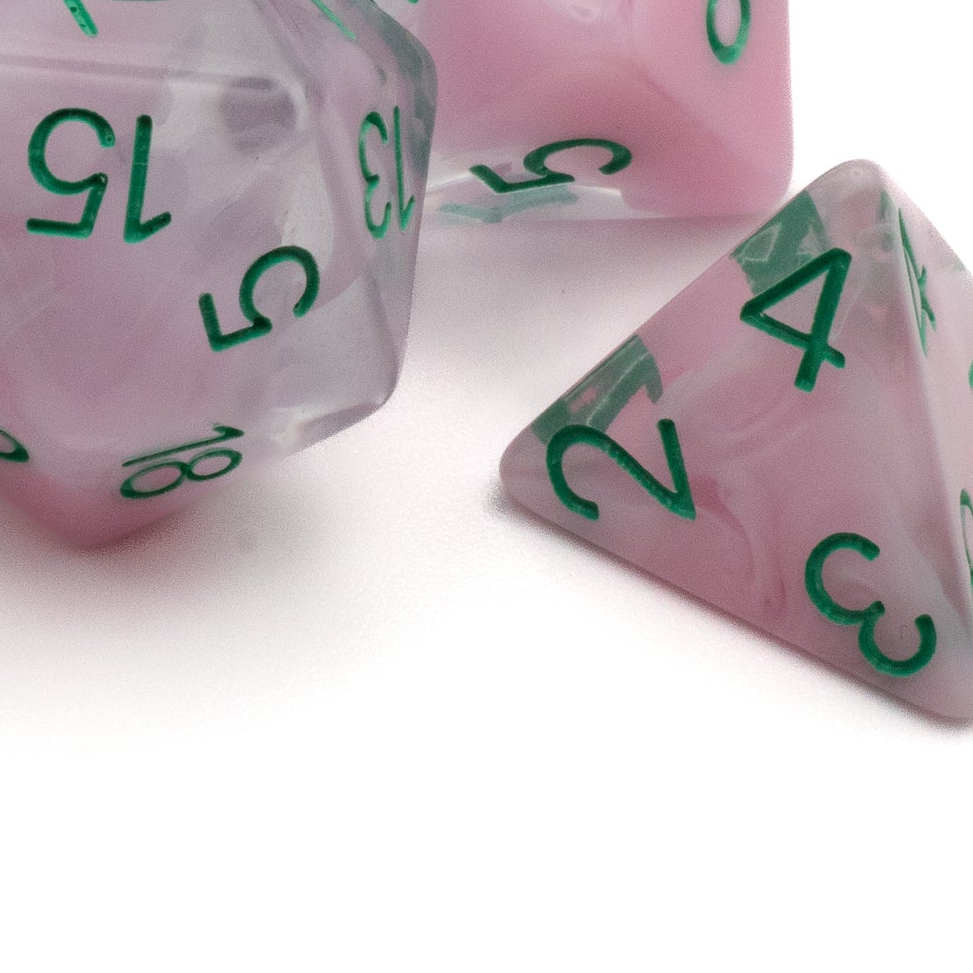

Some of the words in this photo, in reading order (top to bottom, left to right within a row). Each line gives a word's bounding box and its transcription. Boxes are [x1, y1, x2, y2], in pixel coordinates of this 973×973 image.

[27, 108, 172, 244] 15
[358, 105, 415, 240] 13
[467, 138, 633, 195] 5
[198, 245, 320, 352] 5
[740, 247, 852, 393] 4
[119, 423, 245, 499] 18
[545, 418, 697, 521] 2
[804, 532, 937, 678] 3
